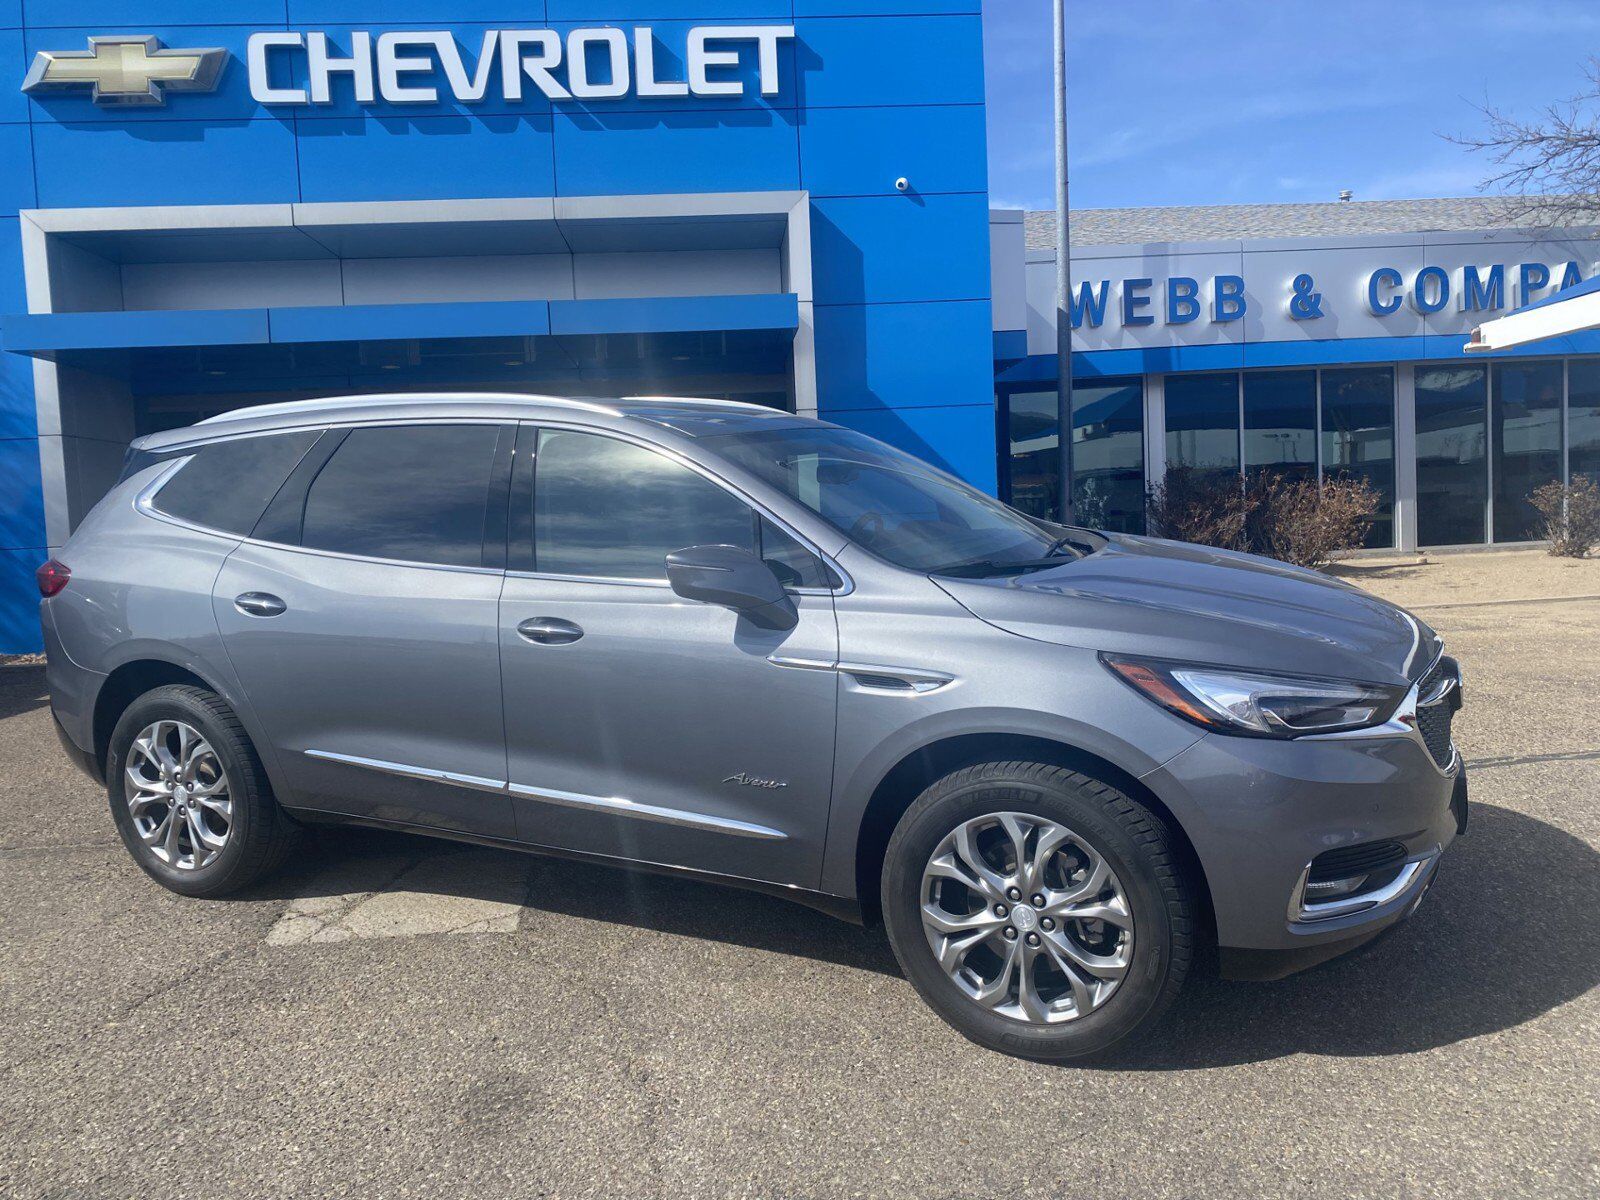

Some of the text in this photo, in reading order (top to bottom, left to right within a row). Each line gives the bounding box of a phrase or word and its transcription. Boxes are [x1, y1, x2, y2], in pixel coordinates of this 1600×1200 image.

[247, 25, 795, 105] CHEVROLET
[1069, 261, 1600, 328] WEBB & COMPA
